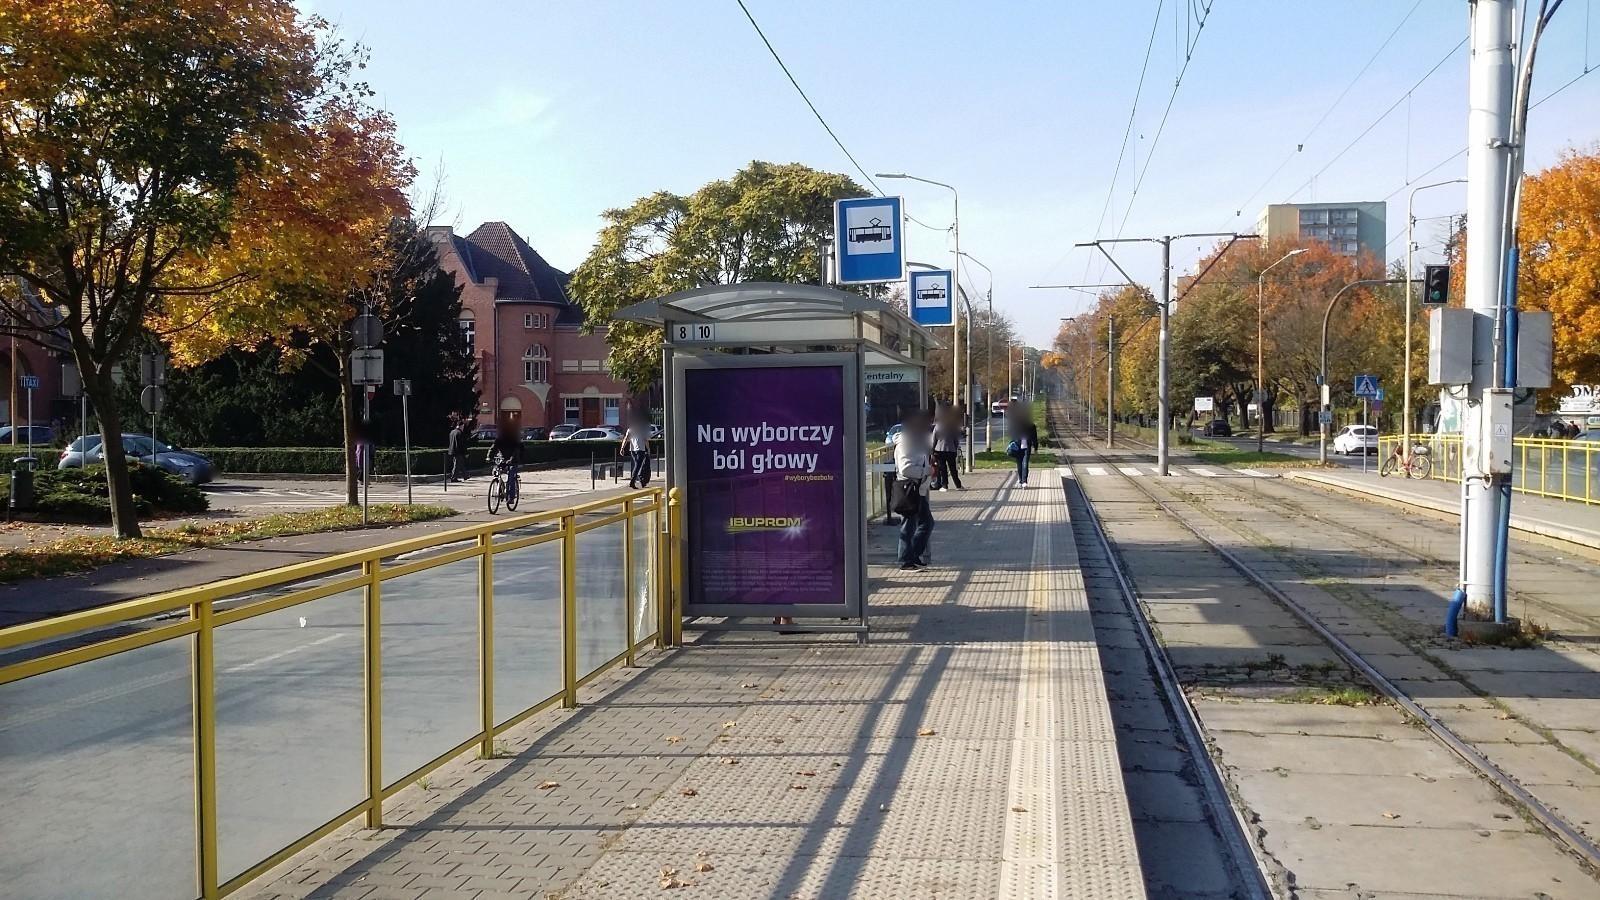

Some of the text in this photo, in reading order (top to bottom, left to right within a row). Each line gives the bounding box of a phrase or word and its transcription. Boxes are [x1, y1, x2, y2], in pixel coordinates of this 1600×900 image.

[680, 325, 711, 339] 8 10
[697, 421, 834, 447] Na wyborczy
[713, 448, 818, 473] ból głowy
[729, 517, 801, 527] IBUPROM
